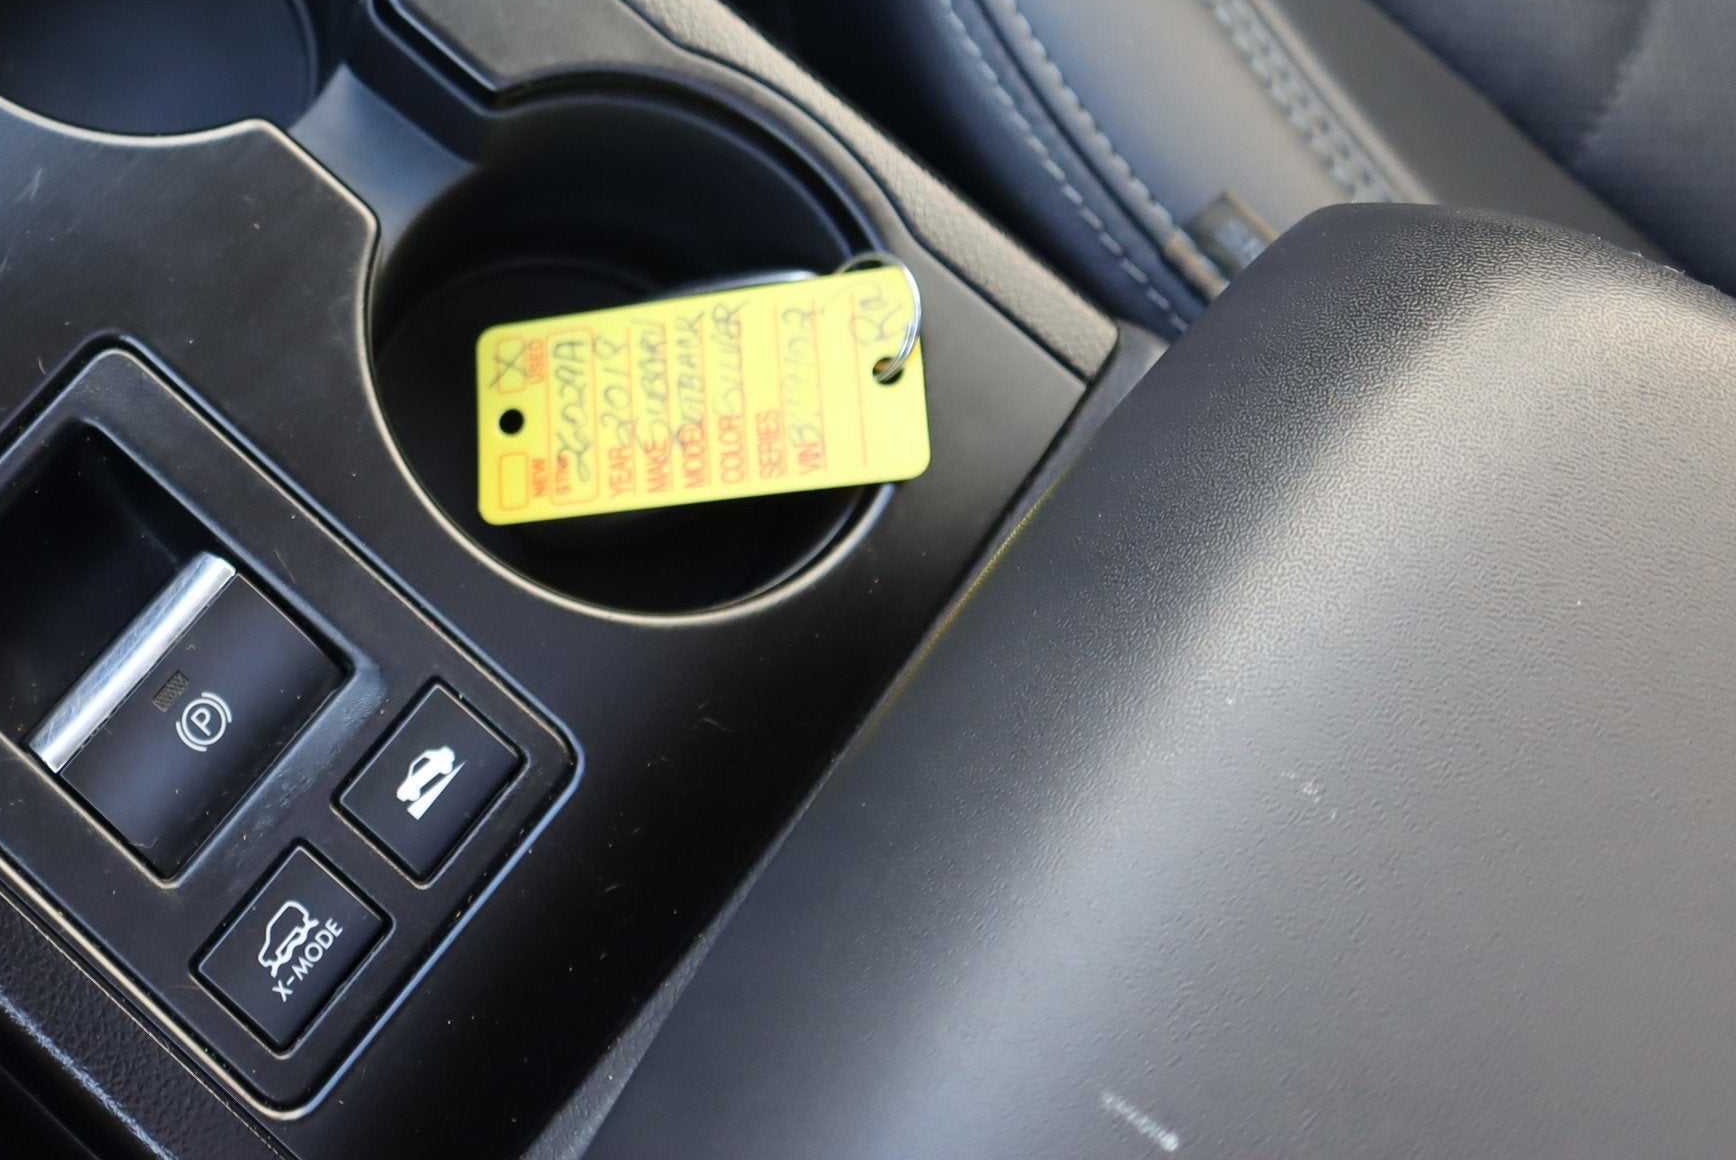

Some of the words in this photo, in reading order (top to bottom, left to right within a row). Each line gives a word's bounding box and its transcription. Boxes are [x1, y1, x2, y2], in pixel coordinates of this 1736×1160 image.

[643, 440, 671, 494] MAKE
[717, 414, 747, 485] COLOR
[756, 410, 787, 480] SERIES
[795, 439, 822, 477] VIN
[531, 457, 548, 499] NEW
[609, 446, 633, 499] YEAR
[271, 918, 343, 1002] X-MODE
